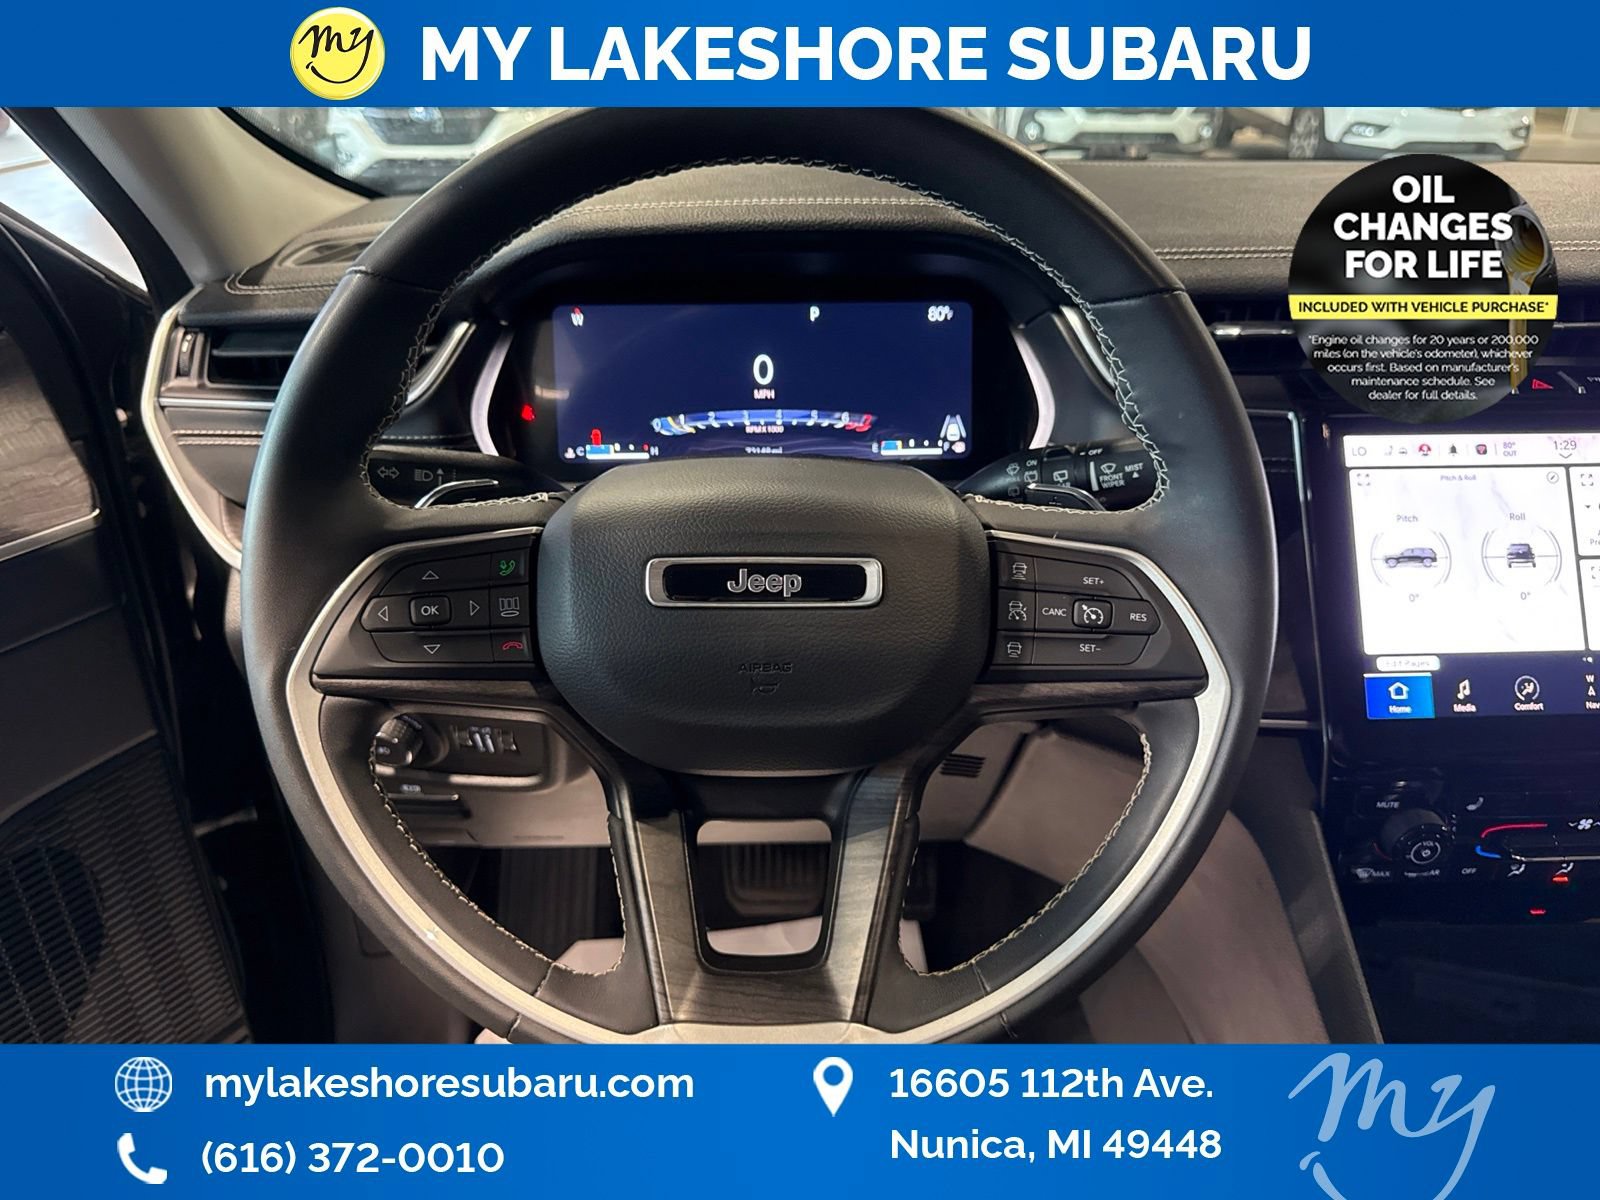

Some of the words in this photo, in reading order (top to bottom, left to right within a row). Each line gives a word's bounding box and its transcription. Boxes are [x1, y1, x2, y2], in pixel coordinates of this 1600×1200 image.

[809, 305, 820, 322] P
[752, 353, 775, 385] 0
[753, 389, 775, 400] MPH
[1554, 440, 1577, 450] 1:29
[1088, 448, 1103, 456] OFF
[1026, 459, 1038, 467] ON
[1125, 463, 1144, 472] MIST
[1100, 473, 1124, 482] FRONT
[1101, 480, 1125, 489] WIPER
[1396, 514, 1418, 523] Pitch
[1509, 512, 1526, 522] Roll
[726, 569, 802, 597] Jeep
[1083, 576, 1105, 586] SET+
[421, 604, 439, 616] OK
[1042, 607, 1067, 617] CANC
[1130, 613, 1147, 622] RES
[738, 663, 793, 674] AIRBAG
[1389, 705, 1412, 713] Home
[1453, 703, 1477, 713] Media
[1514, 702, 1544, 711] Comfort
[1376, 801, 1400, 809] MUTE
[1461, 867, 1477, 875] OFF
